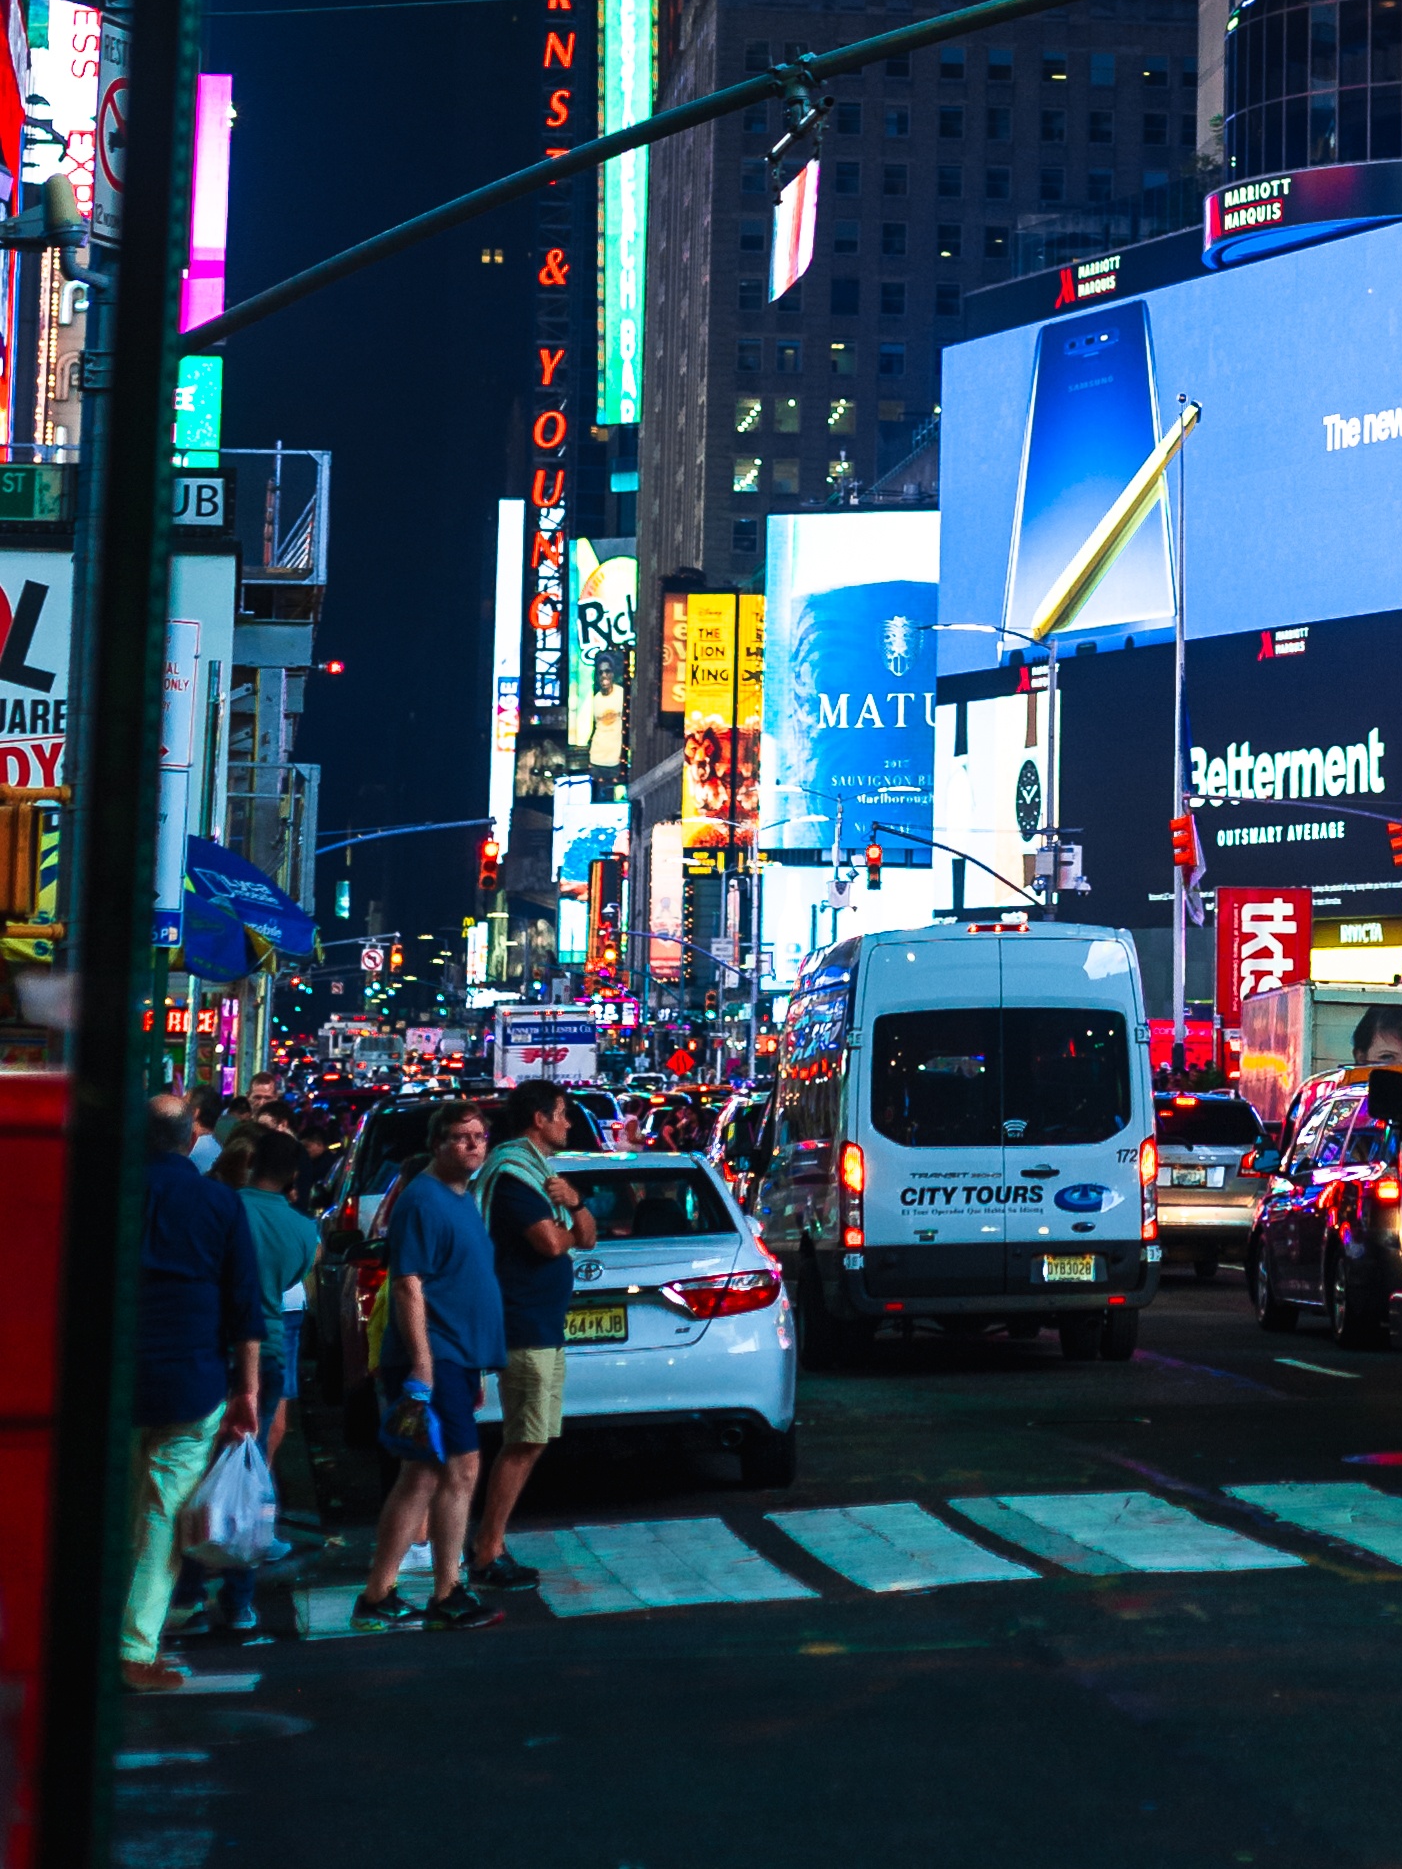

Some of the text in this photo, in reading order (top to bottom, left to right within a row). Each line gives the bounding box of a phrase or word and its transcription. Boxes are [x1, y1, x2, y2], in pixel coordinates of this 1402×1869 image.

[1224, 177, 1292, 208] MARRIOTT
[1224, 201, 1282, 231] MARQUIS
[538, 247, 569, 286] &
[1078, 255, 1121, 279] MARRIOTT
[1078, 275, 1116, 298] MARQUIS
[1323, 413, 1361, 452] The
[527, 347, 568, 631] YOUNG
[698, 627, 721, 639] THE
[693, 642, 726, 661] LION
[690, 663, 730, 687] KING
[1190, 726, 1386, 809] Betterment
[831, 775, 912, 787] SAUVIGNON
[1216, 821, 1345, 847] OUTSMART AVERAGE
[1240, 897, 1298, 1002] tkts
[1116, 1148, 1138, 1164] 172
[909, 1171, 969, 1180] TRANSIT
[900, 1184, 1044, 1207] CITY TOURS
